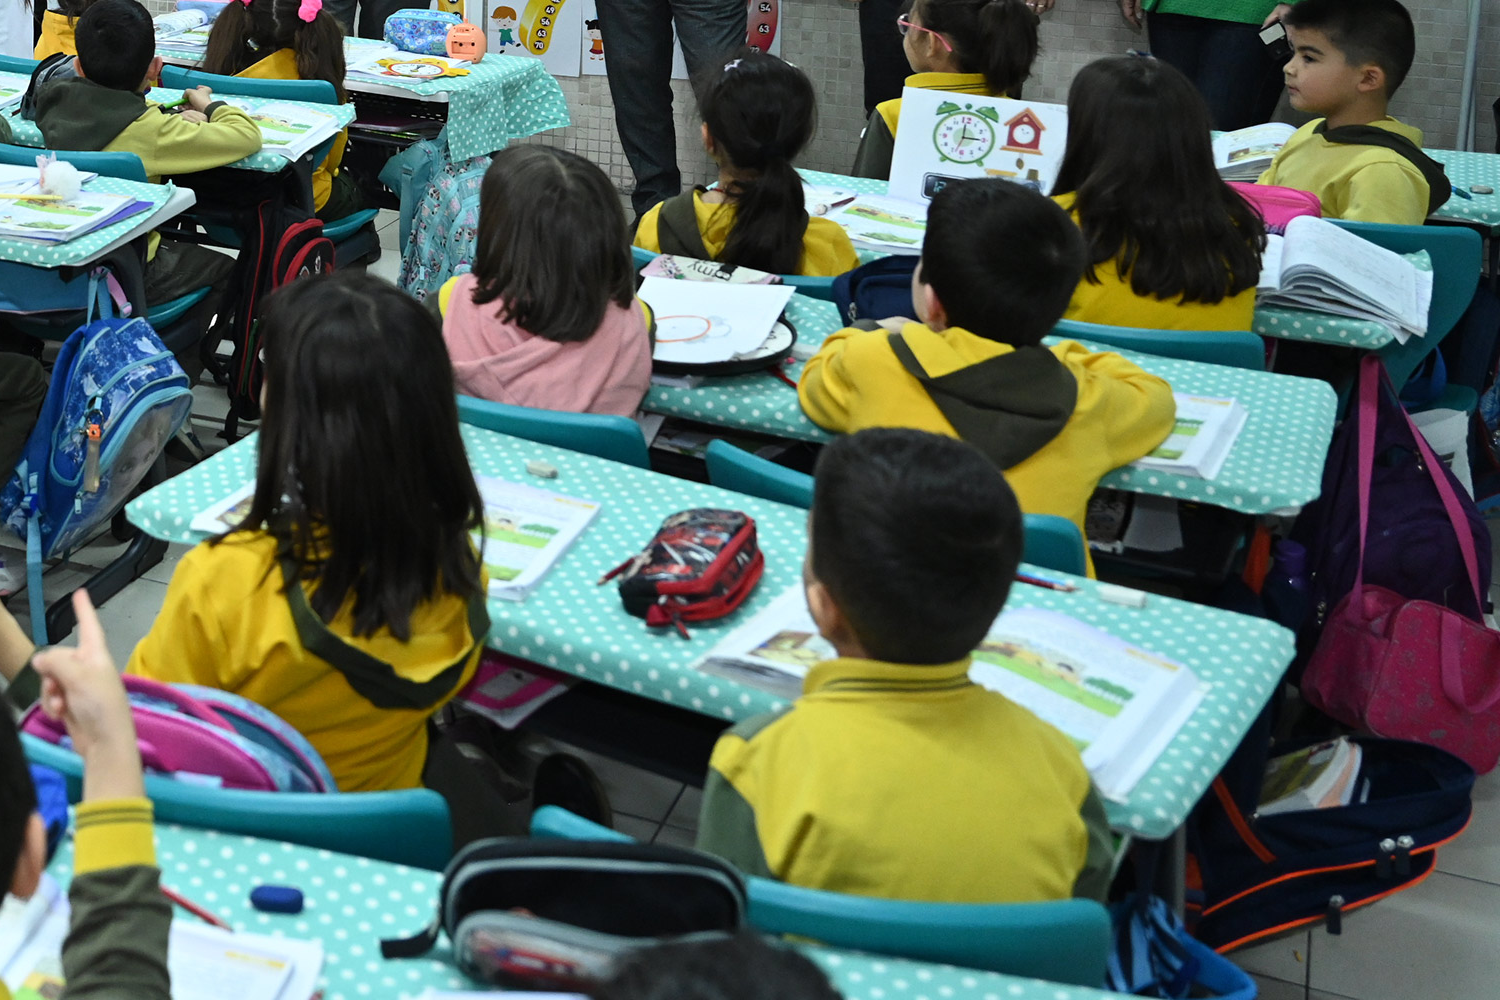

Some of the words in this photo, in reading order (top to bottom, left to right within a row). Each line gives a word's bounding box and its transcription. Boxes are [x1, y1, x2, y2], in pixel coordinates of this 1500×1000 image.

[545, 6, 556, 15] 49
[760, 3, 771, 13] 54
[540, 18, 551, 27] 56
[536, 29, 547, 38] 63
[758, 24, 770, 34] 63
[533, 41, 544, 50] 70
